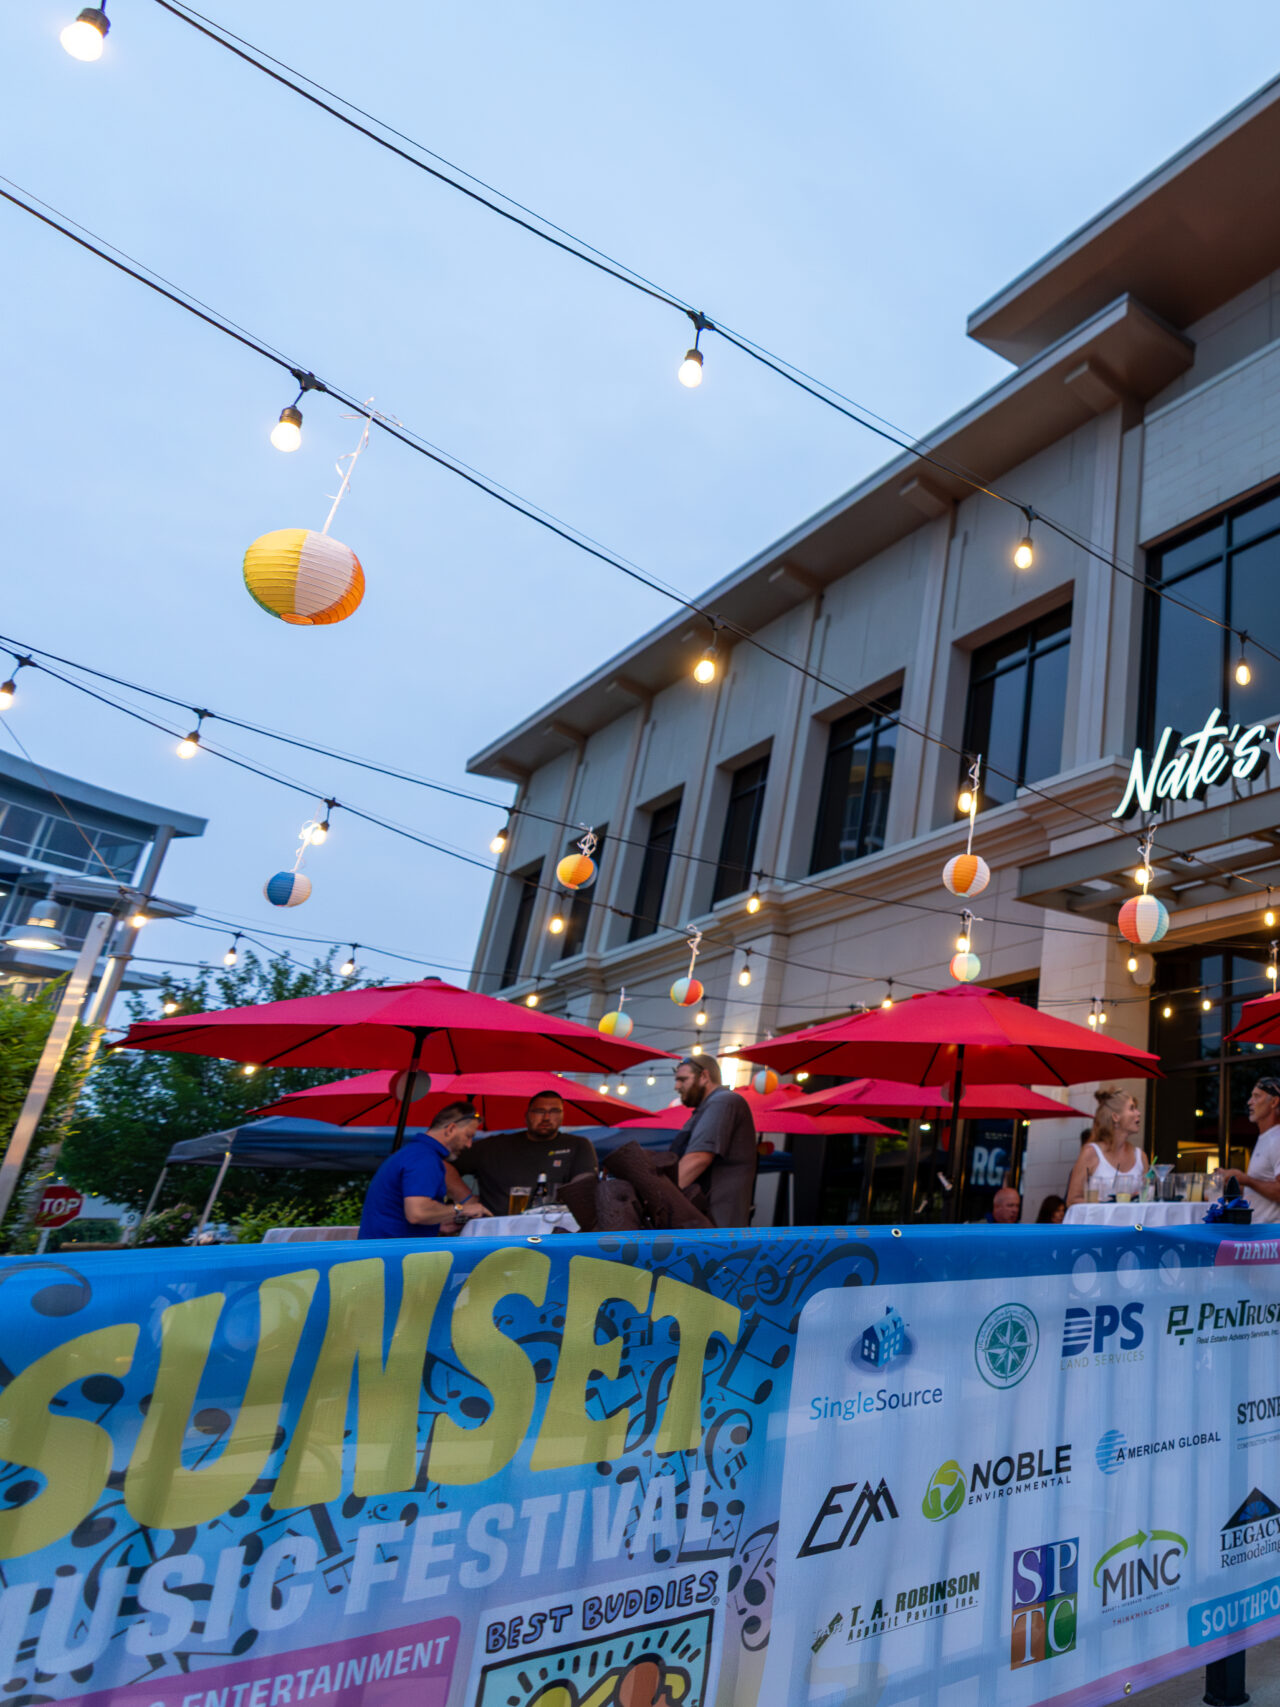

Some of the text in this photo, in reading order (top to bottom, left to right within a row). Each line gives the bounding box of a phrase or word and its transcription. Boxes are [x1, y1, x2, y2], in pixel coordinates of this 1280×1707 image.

[1112, 707, 1268, 820] Nate's
[40, 1197, 81, 1215] TOP
[1234, 1242, 1279, 1260] THANK
[1061, 1301, 1145, 1358] DPS
[1060, 1350, 1145, 1371] LAND SERVICES
[0, 1247, 742, 1560] SUNSET
[809, 1387, 943, 1421] SingleSource
[969, 1443, 1073, 1493] NOBLE
[1116, 1431, 1222, 1462] AMERICAN GLOBAL
[968, 1474, 1073, 1506] ENVIRONMENTAL
[344, 1470, 713, 1615] FESTIVAL
[851, 1571, 981, 1627] T. A. ROBINSON
[1102, 1547, 1182, 1607] MINC
[485, 1570, 719, 1654] BEST BUDDIES
[847, 1595, 979, 1642] Asphalt Paving Inc.
